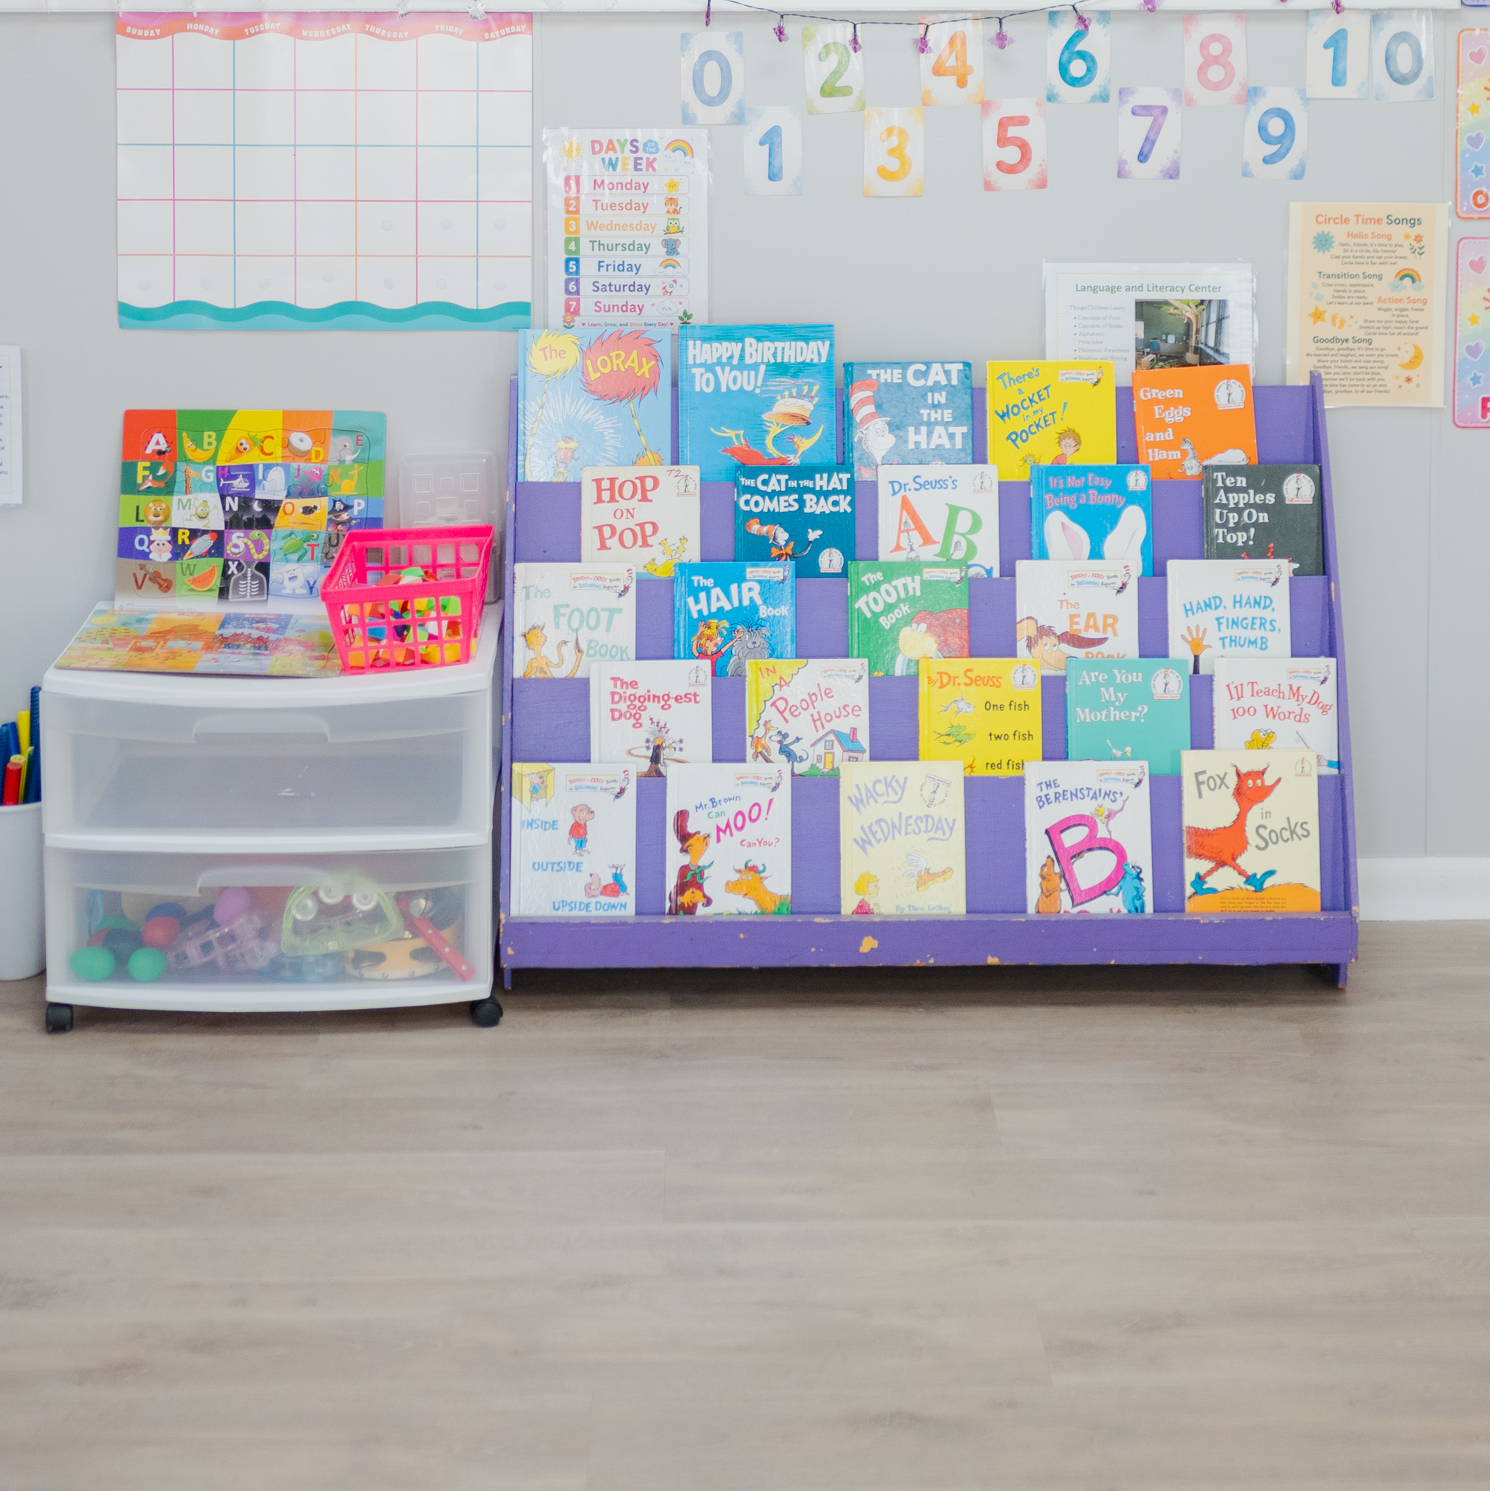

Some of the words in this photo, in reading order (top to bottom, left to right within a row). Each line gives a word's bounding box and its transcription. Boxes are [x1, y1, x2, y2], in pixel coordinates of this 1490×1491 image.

[126, 26, 160, 36] SUNDAY
[187, 23, 220, 36] MONDAY
[244, 23, 280, 35] TUESDAY
[301, 24, 351, 37] WEDNESDAY
[365, 24, 408, 39] THURSDAY
[435, 25, 464, 35] FRIDAY
[484, 25, 526, 40] SATURDAY
[932, 30, 974, 89] 4
[1058, 28, 1098, 88] 6
[1130, 104, 1168, 164] 7
[591, 139, 639, 155] DAYS
[996, 115, 1033, 174] 5
[601, 157, 657, 172] WEEK
[593, 179, 649, 192] Monday
[593, 199, 649, 213] Tuesday
[586, 220, 657, 234] Wednesday
[1315, 214, 1350, 225] Circle
[1354, 214, 1383, 225] Time
[1386, 215, 1422, 228] Songs
[1371, 232, 1392, 241] Song
[589, 240, 651, 254] Thursday
[597, 261, 642, 275] Friday
[1362, 272, 1383, 281] Song
[592, 281, 651, 295] Saturday
[1076, 284, 1122, 294] Language
[1125, 284, 1144, 292] and
[1147, 284, 1186, 294] Literacy
[1189, 284, 1222, 293] Center
[594, 301, 644, 315] Sunday
[1313, 336, 1350, 344] Goodbye
[1352, 337, 1372, 345] Song
[688, 339, 742, 365] HAPPY
[744, 338, 831, 364] BIRTHDAY
[539, 346, 567, 362] The
[585, 349, 656, 381] LORAX
[867, 369, 902, 383] THE
[907, 363, 963, 387] CAT
[927, 392, 946, 404] IN
[1140, 386, 1183, 401] Green
[920, 409, 953, 422] THE
[1153, 404, 1191, 423] Eggs
[908, 426, 967, 449] HAT
[1145, 428, 1174, 441] and
[1147, 447, 1182, 460] Ham
[1049, 476, 1065, 489] It's
[1067, 476, 1086, 488] Not
[1088, 472, 1112, 489] Easy
[1214, 472, 1247, 488] Ten
[592, 475, 660, 505] HOP
[1214, 490, 1275, 505] Apples
[1045, 494, 1076, 510] Being
[1079, 495, 1087, 504] a
[1088, 490, 1126, 508] Bunny
[613, 507, 636, 520] ON
[1215, 509, 1238, 527] Up
[1241, 510, 1269, 524] On
[593, 521, 659, 552] POP
[1215, 527, 1255, 547] Top!
[1183, 596, 1227, 618] HAND,
[1232, 594, 1276, 614] HAND,
[1215, 617, 1282, 634] FINGERS,
[1219, 636, 1268, 651] THUMB
[610, 677, 639, 690] The
[927, 676, 938, 687] By
[937, 671, 961, 689] Dr.
[964, 669, 1002, 688] Seuss
[1077, 670, 1107, 684] Are
[1112, 668, 1143, 683] You
[1100, 687, 1128, 706] My
[985, 701, 1005, 711] One
[1009, 700, 1029, 711] fish
[610, 708, 643, 729] Dog
[1075, 705, 1148, 723] Mother?
[989, 732, 1009, 741] two
[1013, 730, 1033, 741] fish
[1193, 769, 1230, 799] Fox
[1261, 808, 1271, 820] in
[1255, 819, 1311, 851] Socks
